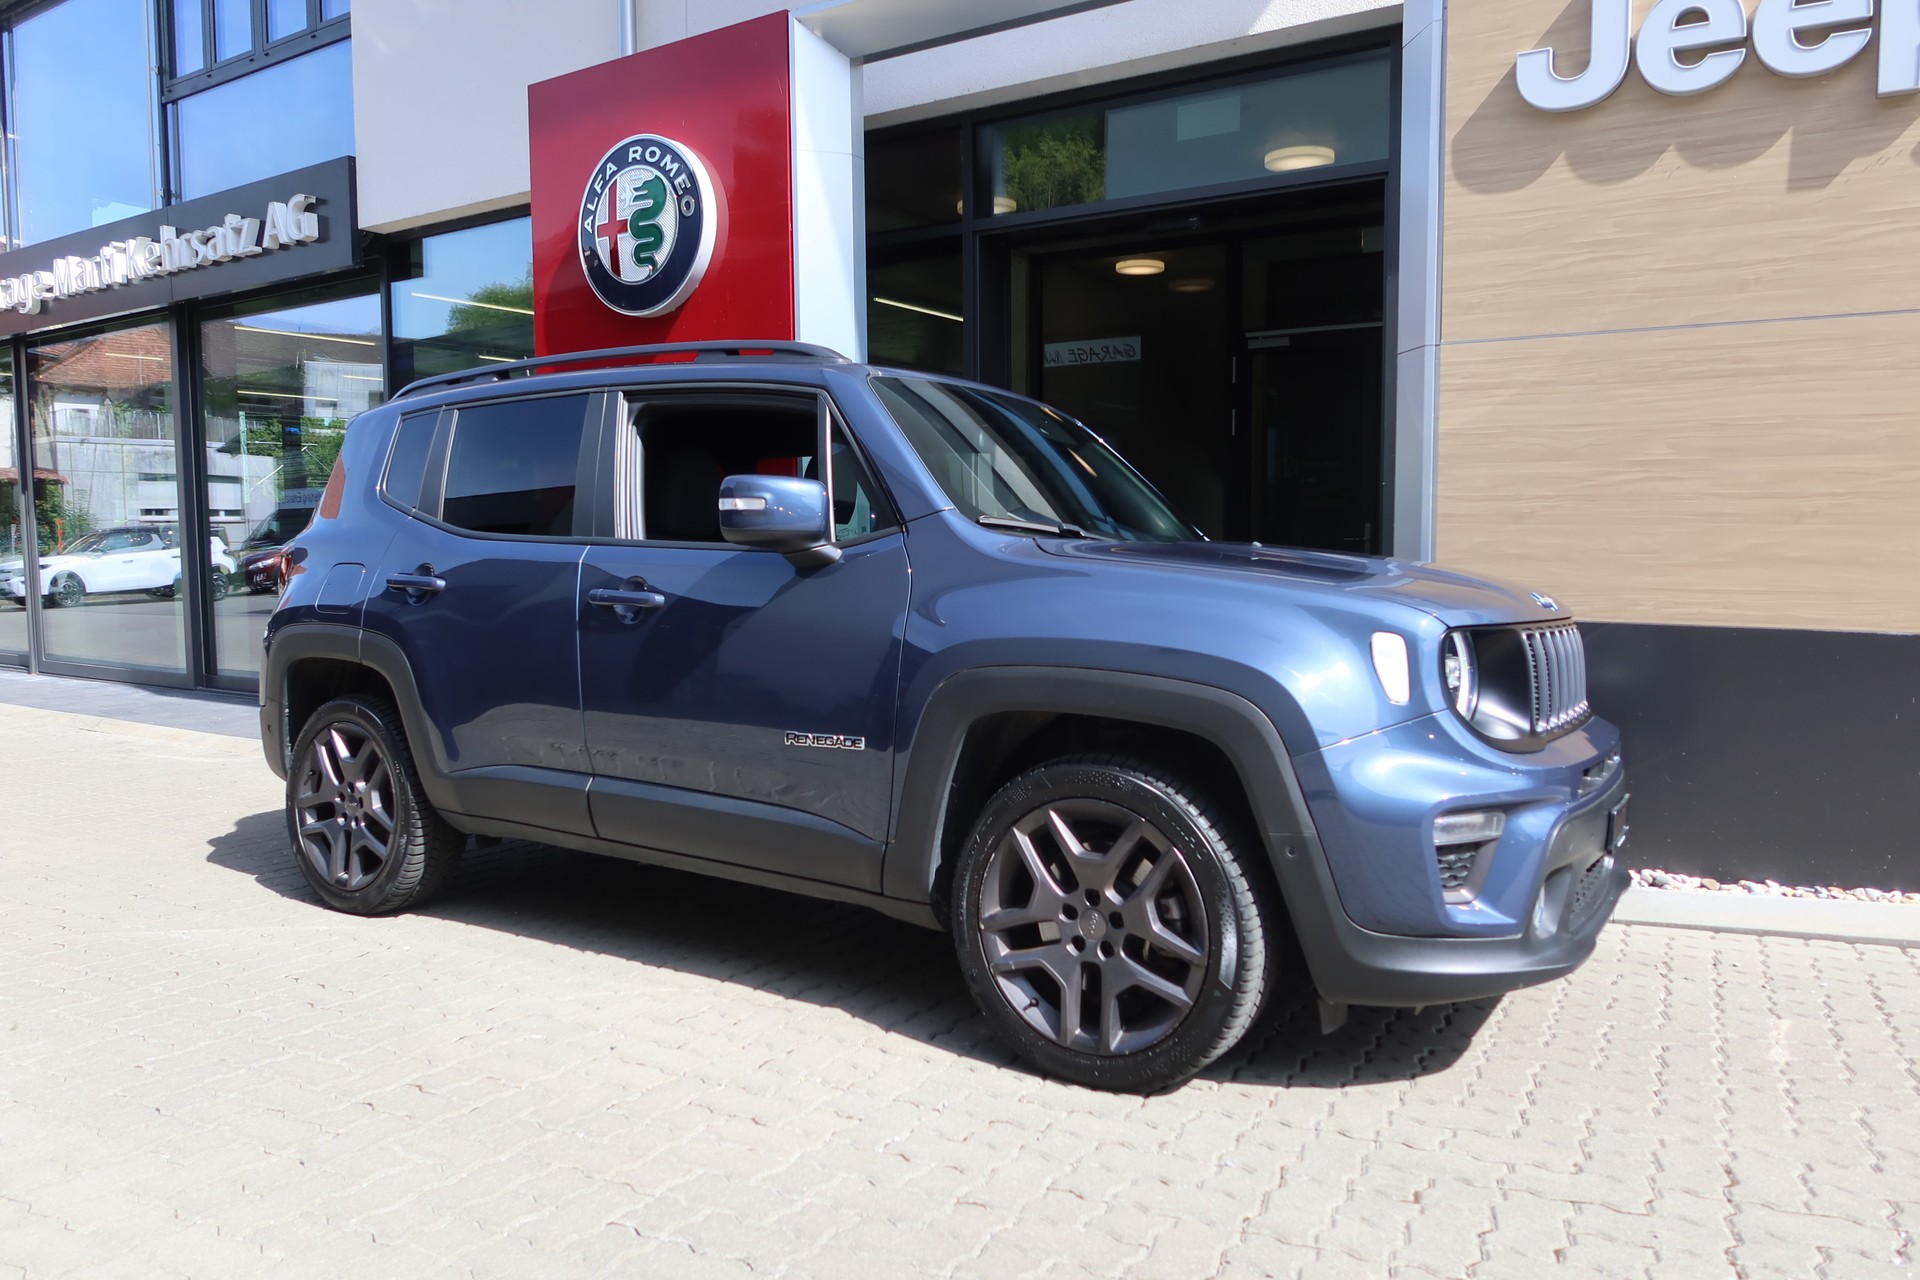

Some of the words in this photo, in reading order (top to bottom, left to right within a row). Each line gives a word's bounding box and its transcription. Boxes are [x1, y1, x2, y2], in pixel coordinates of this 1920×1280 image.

[583, 161, 619, 235] ALFA
[628, 145, 696, 218] ROMEO
[53, 241, 127, 298] Marti
[126, 213, 262, 281] Kehrsatz
[262, 193, 319, 249] AG
[784, 730, 866, 751] RENEGADE
